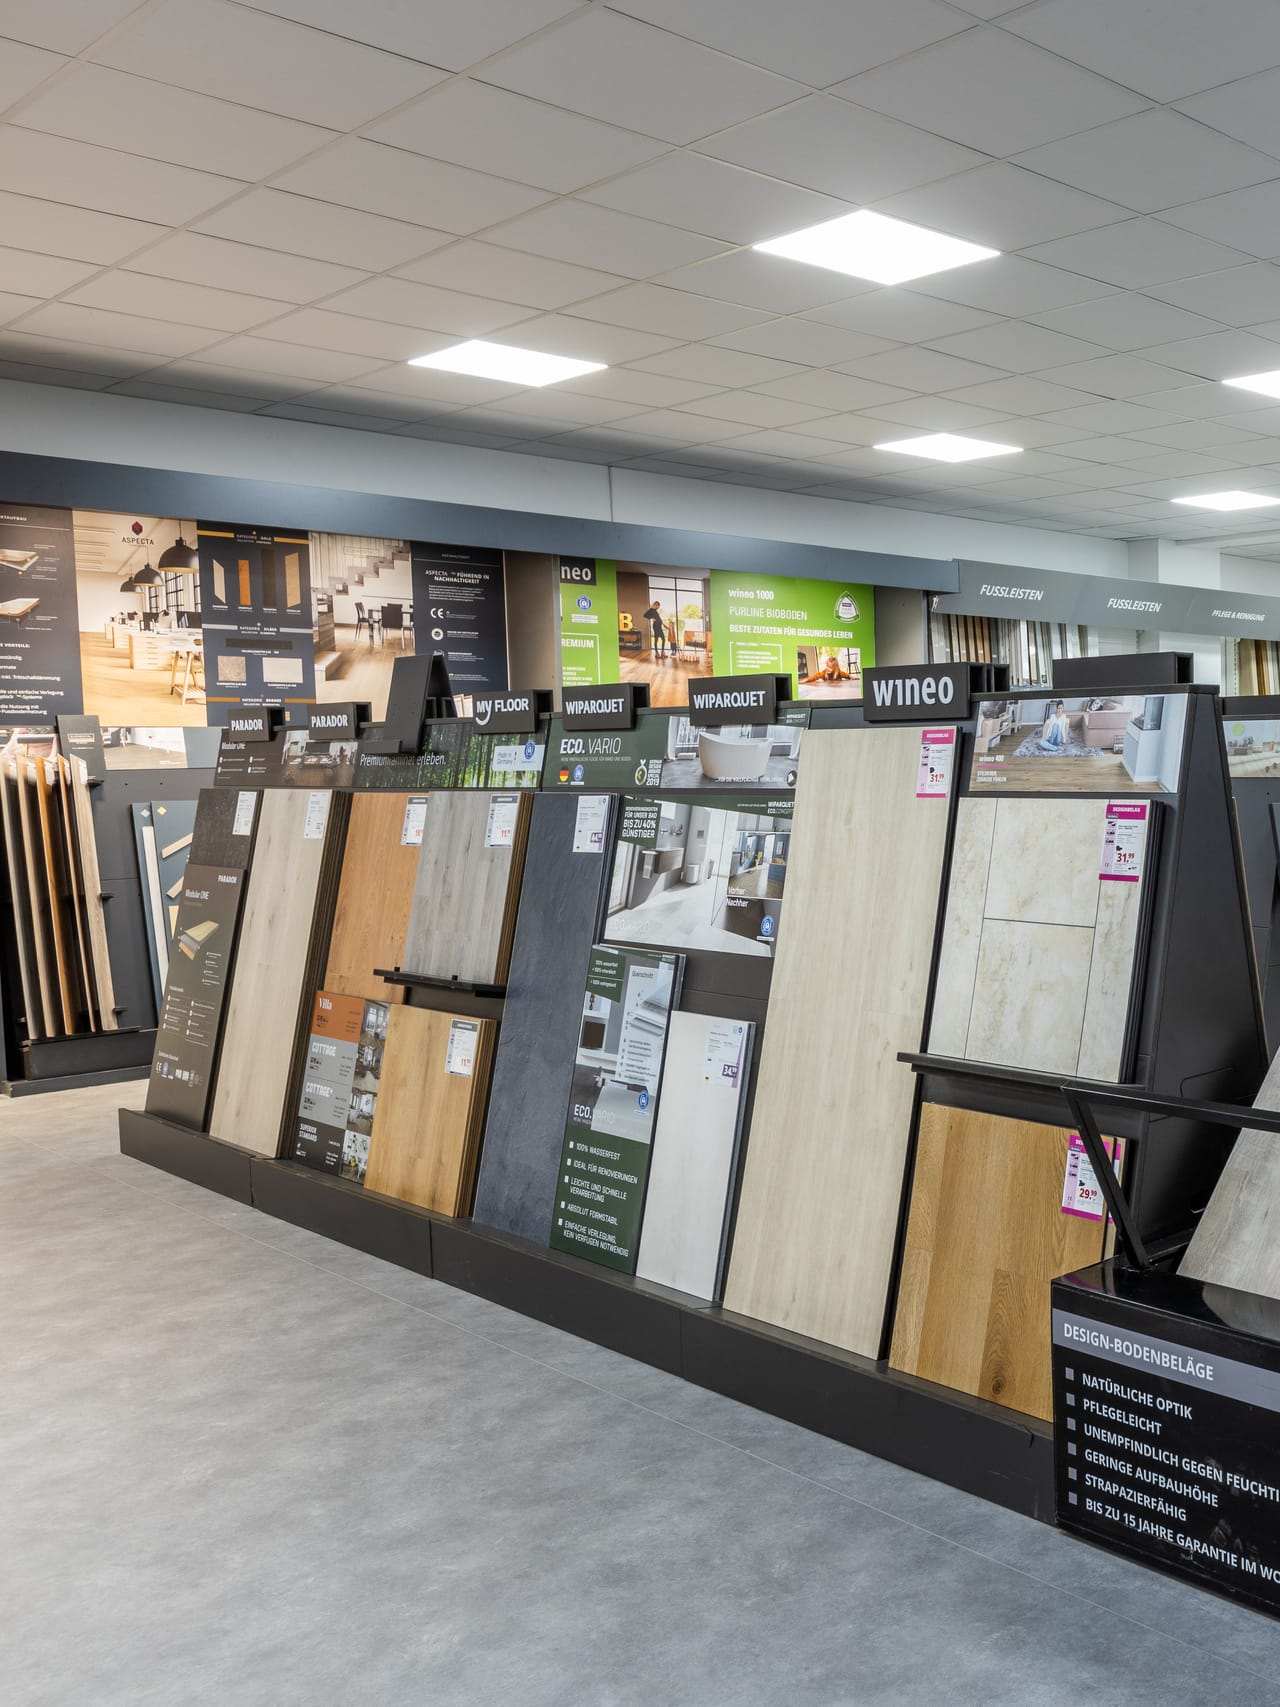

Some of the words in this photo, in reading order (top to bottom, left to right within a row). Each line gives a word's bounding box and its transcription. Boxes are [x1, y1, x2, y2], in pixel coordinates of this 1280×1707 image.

[122, 536, 154, 545] ASPECTA
[434, 576, 480, 584] NACHHALTIGKEIT
[457, 570, 482, 579] FÜHREND
[560, 565, 592, 581] neo
[728, 588, 754, 599] wineo
[757, 590, 774, 600] 1000
[980, 584, 1044, 601] FUSSLEISTEN
[729, 606, 765, 618] PURLINE
[766, 608, 807, 620] BIOBODEN
[1107, 598, 1162, 612] FUSSLEISTEN
[619, 612, 634, 631] B
[1212, 609, 1231, 619] PFLEGE
[1237, 612, 1265, 622] REINIGUNG
[729, 624, 752, 633] BESTE
[753, 625, 782, 635] ZUTATEN
[784, 626, 797, 636] FÜR
[797, 628, 832, 638] GESUNDES
[833, 630, 853, 639] LEBEN
[561, 638, 594, 648] REMIUM
[872, 676, 954, 706] wineo
[495, 698, 529, 712] FLOOR
[565, 698, 624, 715] WIPARQUET
[693, 690, 766, 710] WIPARQUET
[231, 718, 264, 731] PARADOR
[311, 714, 348, 728] PARADOR
[560, 738, 585, 754] ECO.
[588, 737, 622, 754] VARIO
[417, 754, 446, 768] erleben.
[623, 819, 633, 828] BIS
[634, 820, 642, 828] ZU
[643, 820, 656, 829] 40%
[622, 828, 655, 838] GÜNSTIGER
[217, 874, 237, 884] PARADOR
[727, 898, 748, 908] Nachher
[312, 1042, 337, 1057] COTTAGE
[574, 1104, 592, 1120] ECO.
[576, 1142, 588, 1154] 100%
[589, 1145, 620, 1161] WASSERFEST
[574, 1160, 587, 1171] IDEAL
[587, 1162, 597, 1173] FÜR
[598, 1166, 638, 1185] RENOVIERUNGEN
[570, 1187, 605, 1203] VERARBEITUNG
[571, 1177, 590, 1190] LEICHTE
[591, 1182, 601, 1193] UND
[602, 1184, 627, 1200] SCHNELLE
[567, 1203, 588, 1216] ABSOLUT
[589, 1209, 618, 1226] FORMSTABIL
[564, 1220, 587, 1234] EINFACHE
[564, 1230, 574, 1239] KEIN
[575, 1233, 599, 1248] VERFUGEN
[600, 1241, 629, 1257] NOTWENDIG
[1064, 1322, 1214, 1382] DESIGN-BODENBELÄGE
[1082, 1373, 1153, 1407] NATÜRLICHE
[1156, 1397, 1192, 1420] OPTIK
[1084, 1398, 1162, 1436] PFLEGELEICHT
[1084, 1423, 1178, 1468] UNEMPFINDLICH
[1182, 1458, 1223, 1483] GEGEN
[1084, 1448, 1132, 1476] GERINGE
[1135, 1468, 1218, 1508] AUFBAUHÖHE
[1085, 1473, 1187, 1522] STRAPAZIERFÄHIG
[1086, 1498, 1103, 1515] BIS
[1105, 1504, 1120, 1520] ZU
[1123, 1512, 1136, 1527] 15
[1138, 1517, 1174, 1542] JAHRE
[1176, 1533, 1238, 1568] GARANTIE
[1241, 1558, 1257, 1574] IM
